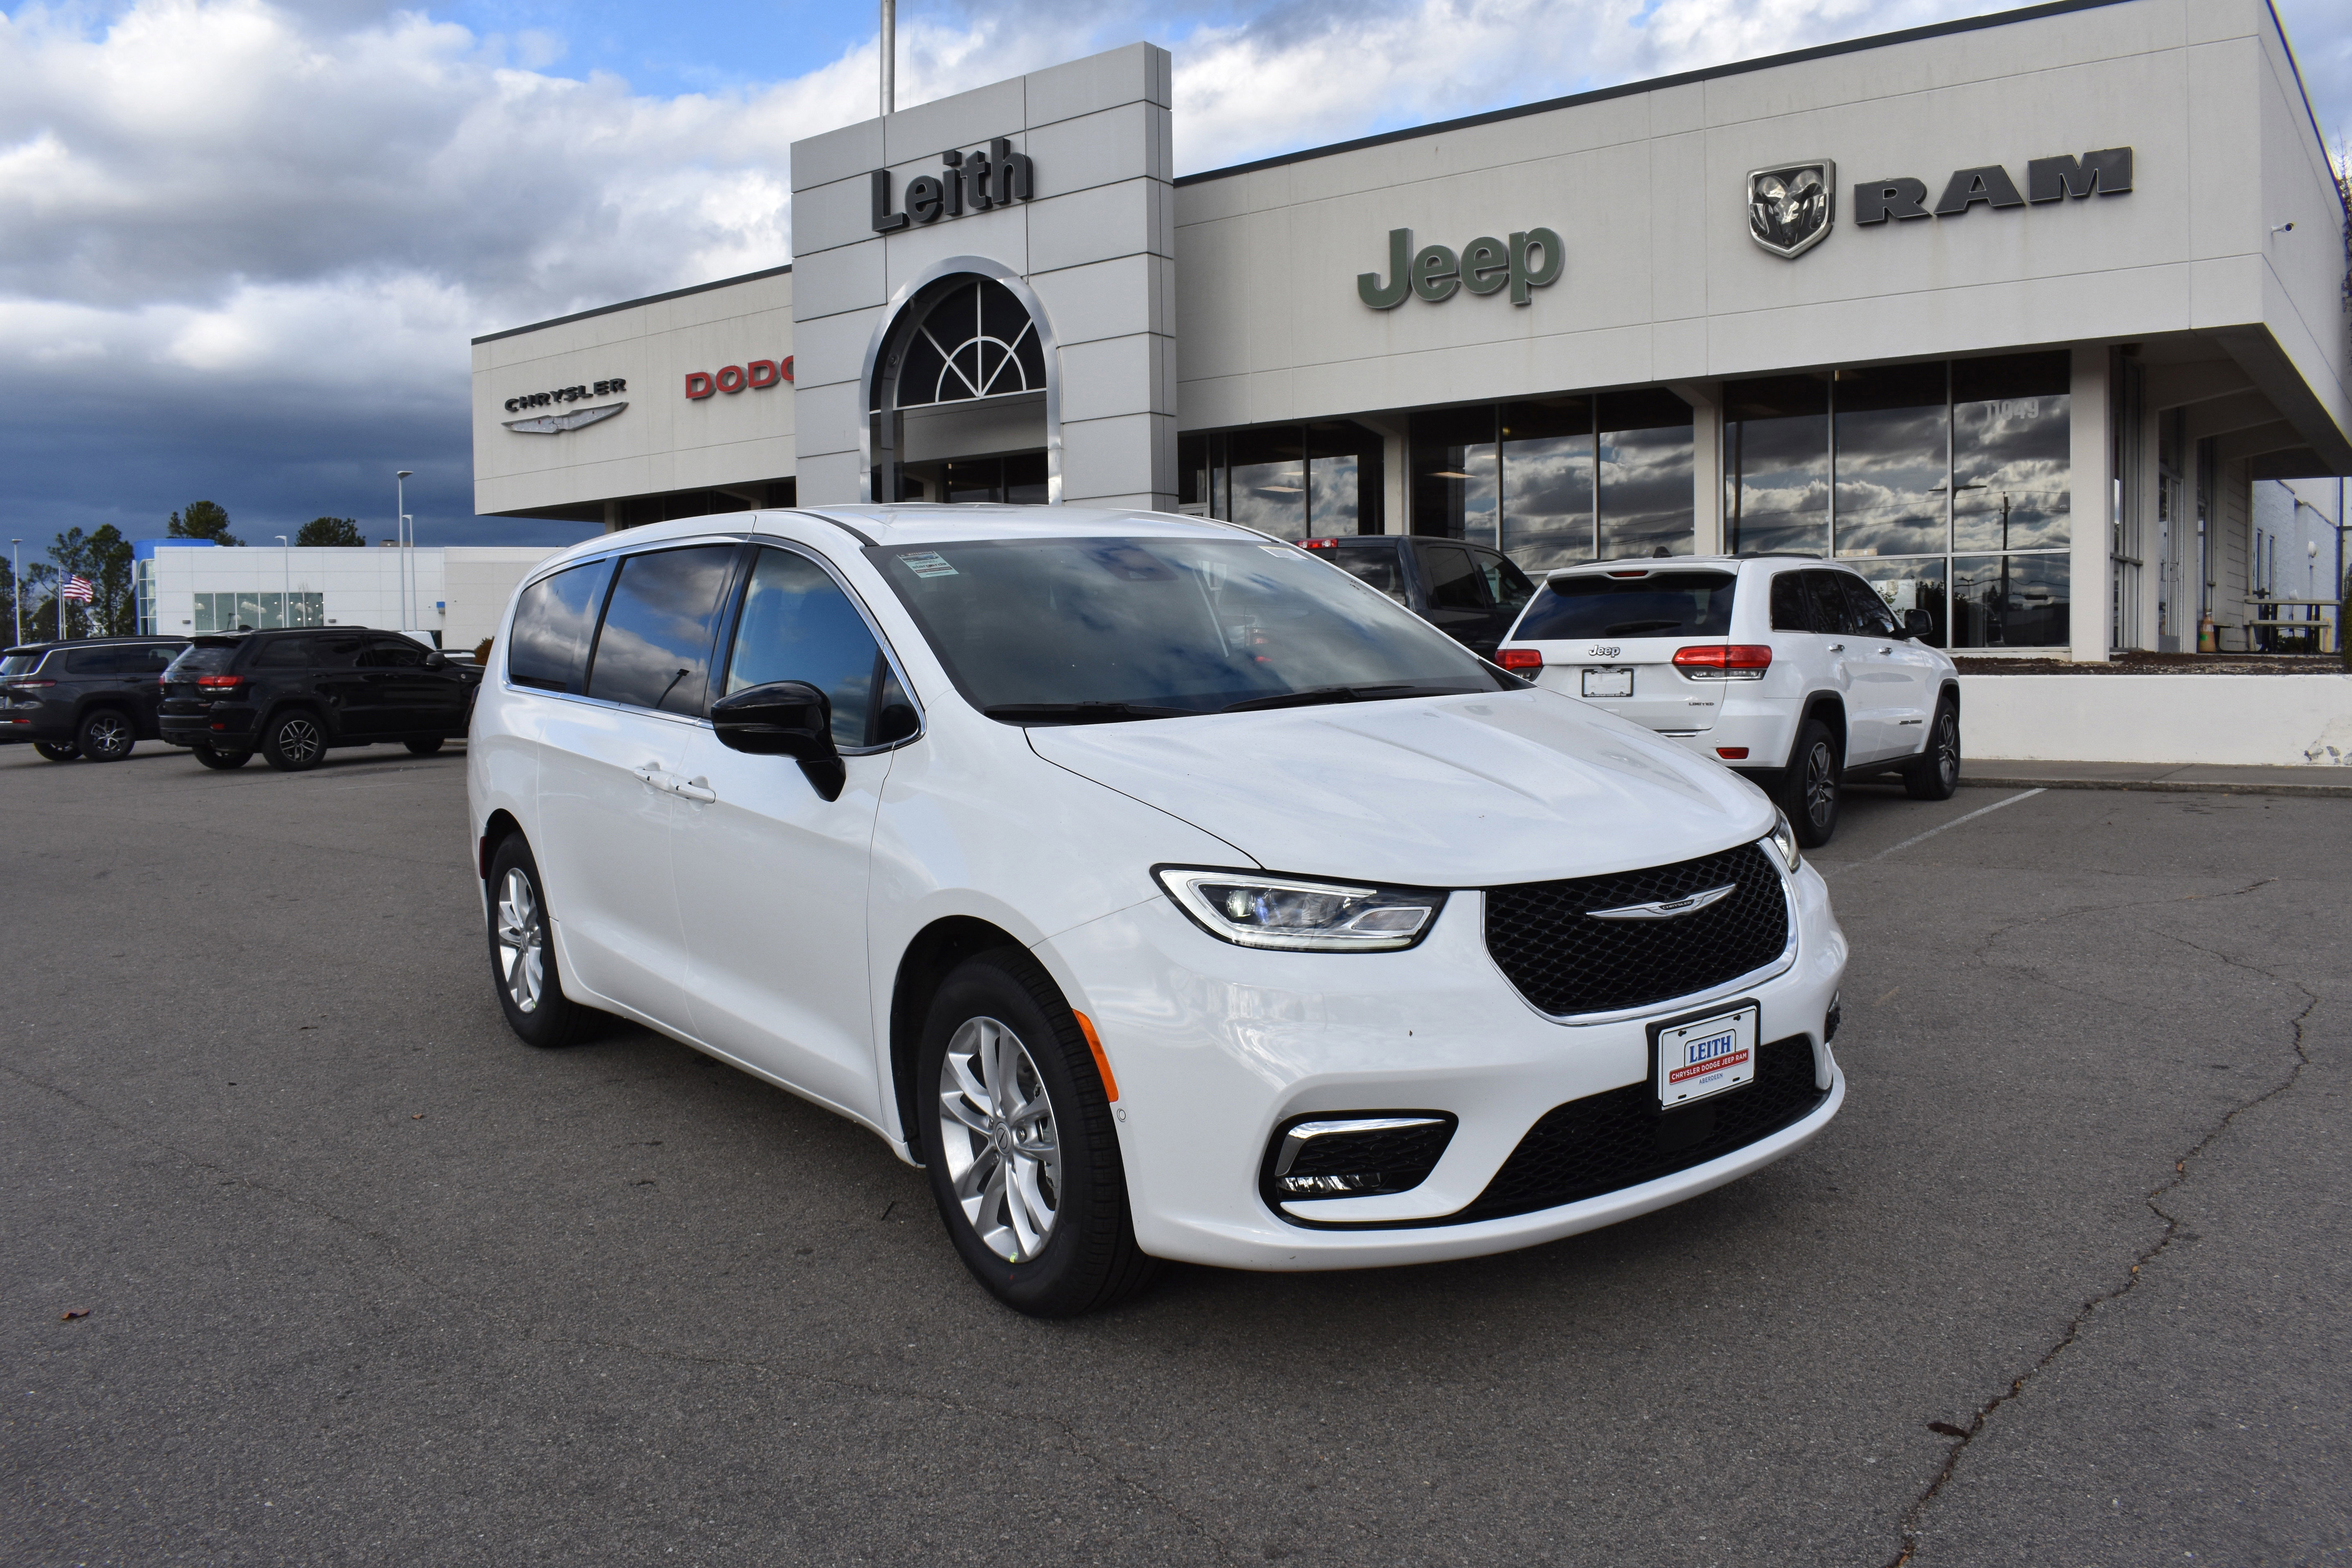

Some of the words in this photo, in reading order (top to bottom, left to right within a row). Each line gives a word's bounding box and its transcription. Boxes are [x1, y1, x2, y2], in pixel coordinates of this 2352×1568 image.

[871, 138, 1033, 233] Leith
[1854, 146, 2134, 226] RAM
[1357, 227, 1565, 309] Jeep
[504, 378, 627, 412] CHRYSLER
[1588, 644, 1620, 658] Jeep
[1662, 901, 1691, 909] CHRYSLER
[1690, 1035, 1731, 1063] LEITH
[1671, 1068, 1700, 1080] CHRYSLER
[1701, 1061, 1720, 1071] DODGE
[1722, 1057, 1734, 1065] JEEP
[1735, 1052, 1747, 1061] RAM
[1699, 1073, 1723, 1084] ABERDEEN
